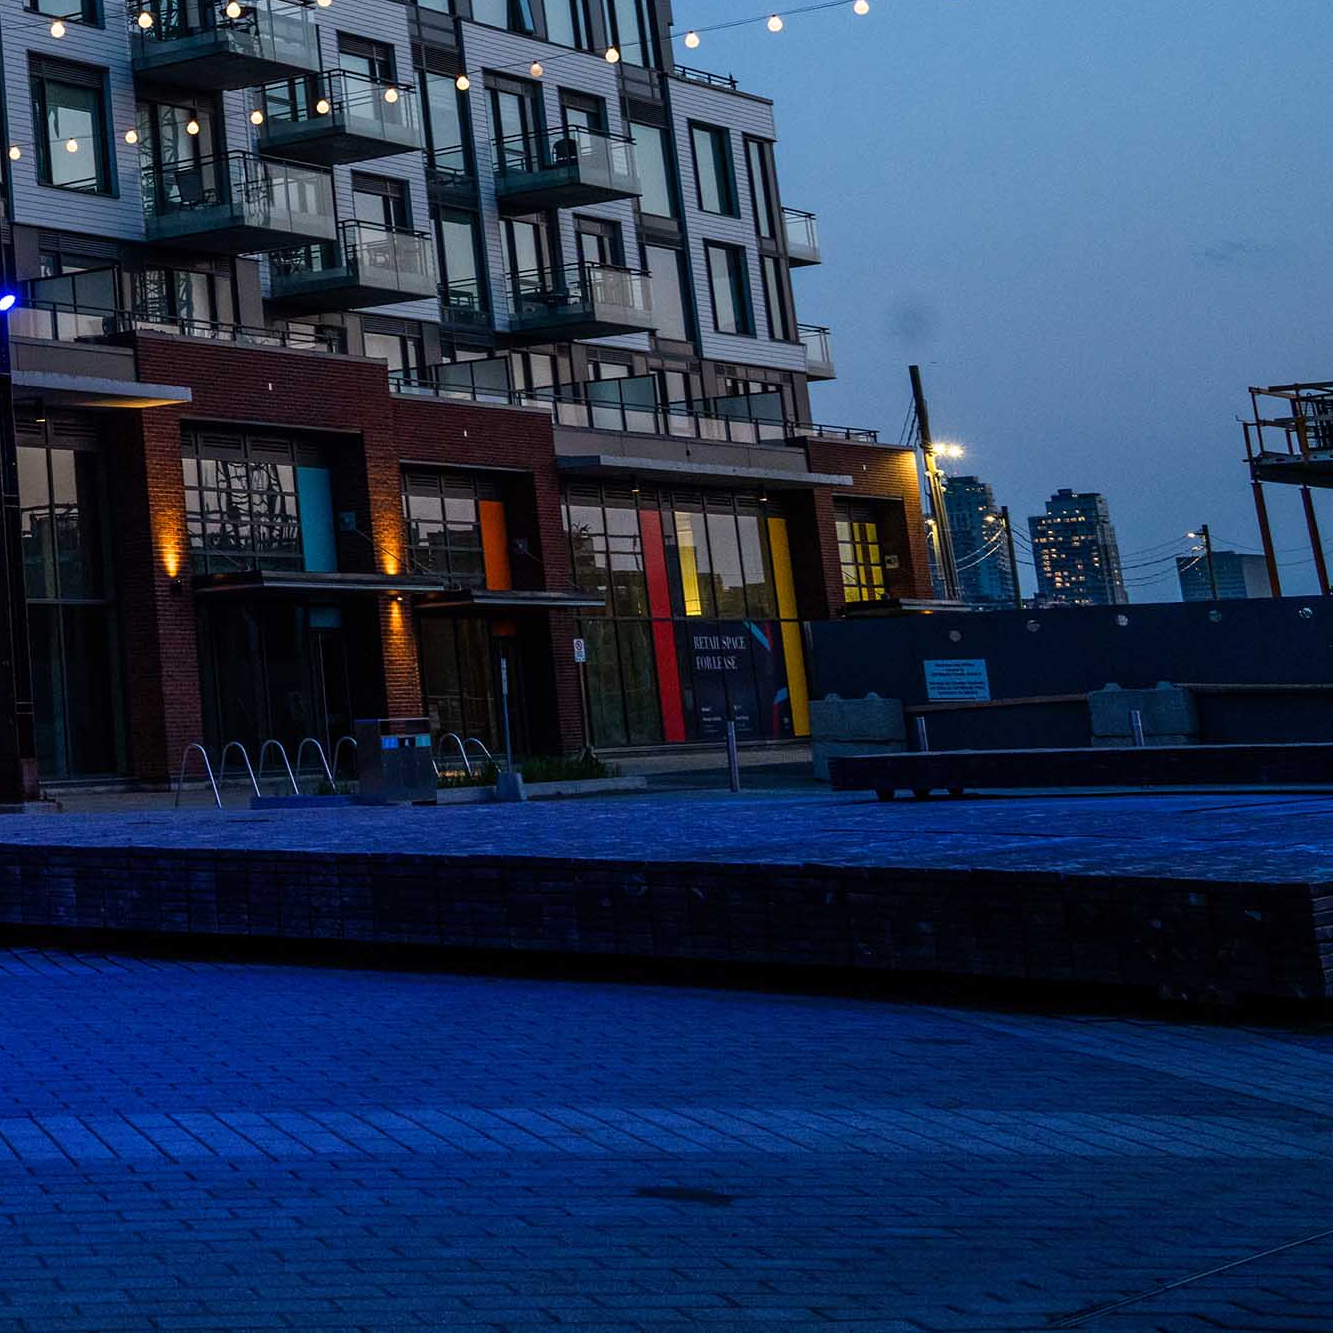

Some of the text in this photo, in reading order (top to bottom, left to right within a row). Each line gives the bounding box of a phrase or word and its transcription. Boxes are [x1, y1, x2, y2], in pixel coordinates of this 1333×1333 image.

[693, 635, 747, 650] RETAIL SPACE
[695, 655, 738, 670] FOR LEASE
